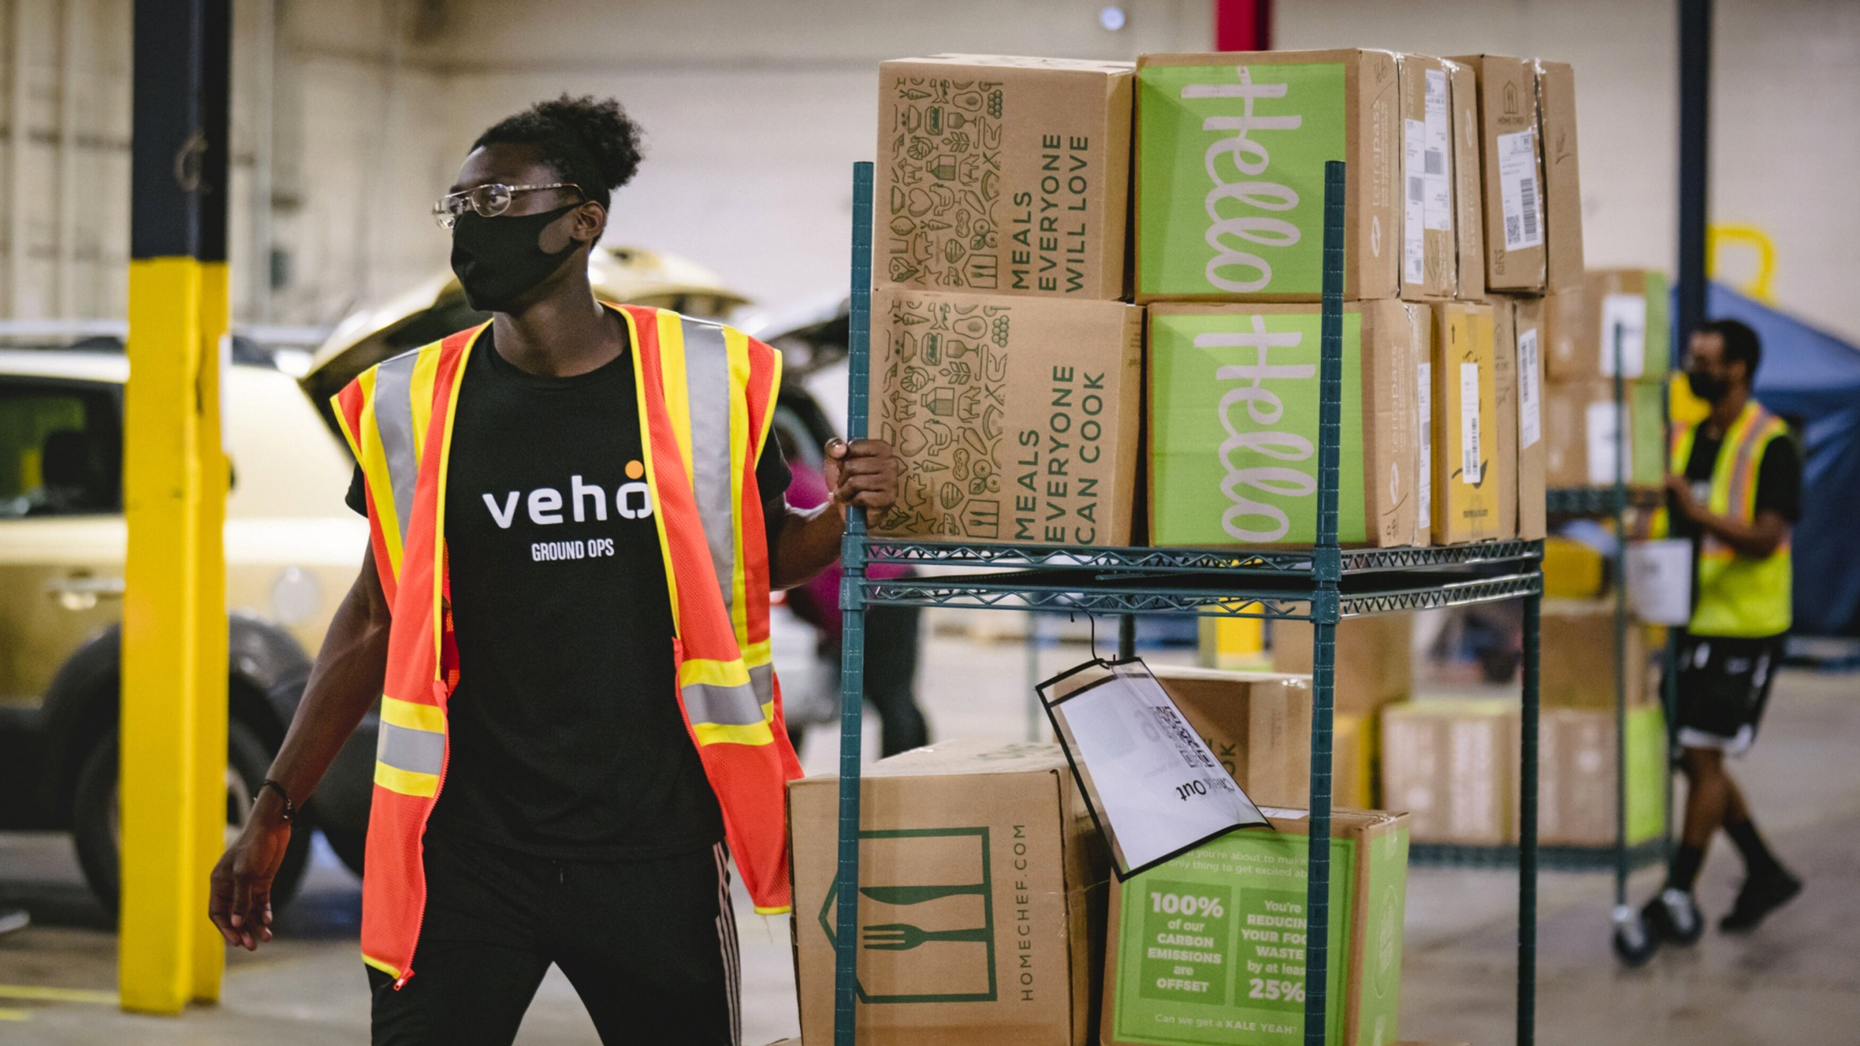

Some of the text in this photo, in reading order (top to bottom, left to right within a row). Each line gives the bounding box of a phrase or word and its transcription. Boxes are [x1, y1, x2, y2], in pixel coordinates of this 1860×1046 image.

[1180, 65, 1302, 293] Hello
[1039, 134, 1061, 291] EVERYONE
[1065, 136, 1089, 293] WILL LOVE
[1012, 191, 1032, 290] MEALS
[1194, 314, 1317, 543] Hello
[1045, 365, 1074, 543] EVERYONE
[1075, 372, 1105, 545] CAN COOK
[1015, 429, 1040, 540] MEALS
[482, 474, 654, 529] veho
[531, 538, 615, 562] GROUND OPS
[1176, 779, 1207, 801] Out
[1168, 859, 1191, 870] only
[1193, 860, 1219, 872] thing
[1222, 863, 1233, 872] to
[1235, 865, 1252, 875] get
[1255, 865, 1292, 877] excited
[1196, 850, 1228, 862] you're
[1231, 851, 1260, 862] about
[1264, 854, 1275, 863] to
[1277, 854, 1307, 865] make
[1013, 824, 1034, 1001] HOMECHEF.COM
[1150, 891, 1225, 919] 100%
[1264, 900, 1302, 913] You're
[1167, 918, 1206, 932] of our
[1247, 914, 1308, 928] REDUCIN
[1157, 932, 1214, 948] CARBON
[1241, 928, 1307, 945] YOUR FOO
[1147, 947, 1222, 965] EMISSIONS
[1256, 945, 1304, 960] WASTE
[1173, 965, 1194, 976] are
[1247, 960, 1306, 976] by at leas
[1156, 977, 1210, 993] OFFSET
[1248, 978, 1306, 1003] 25%
[1155, 1013, 1298, 1035] Can we get a KALE YEAH?
